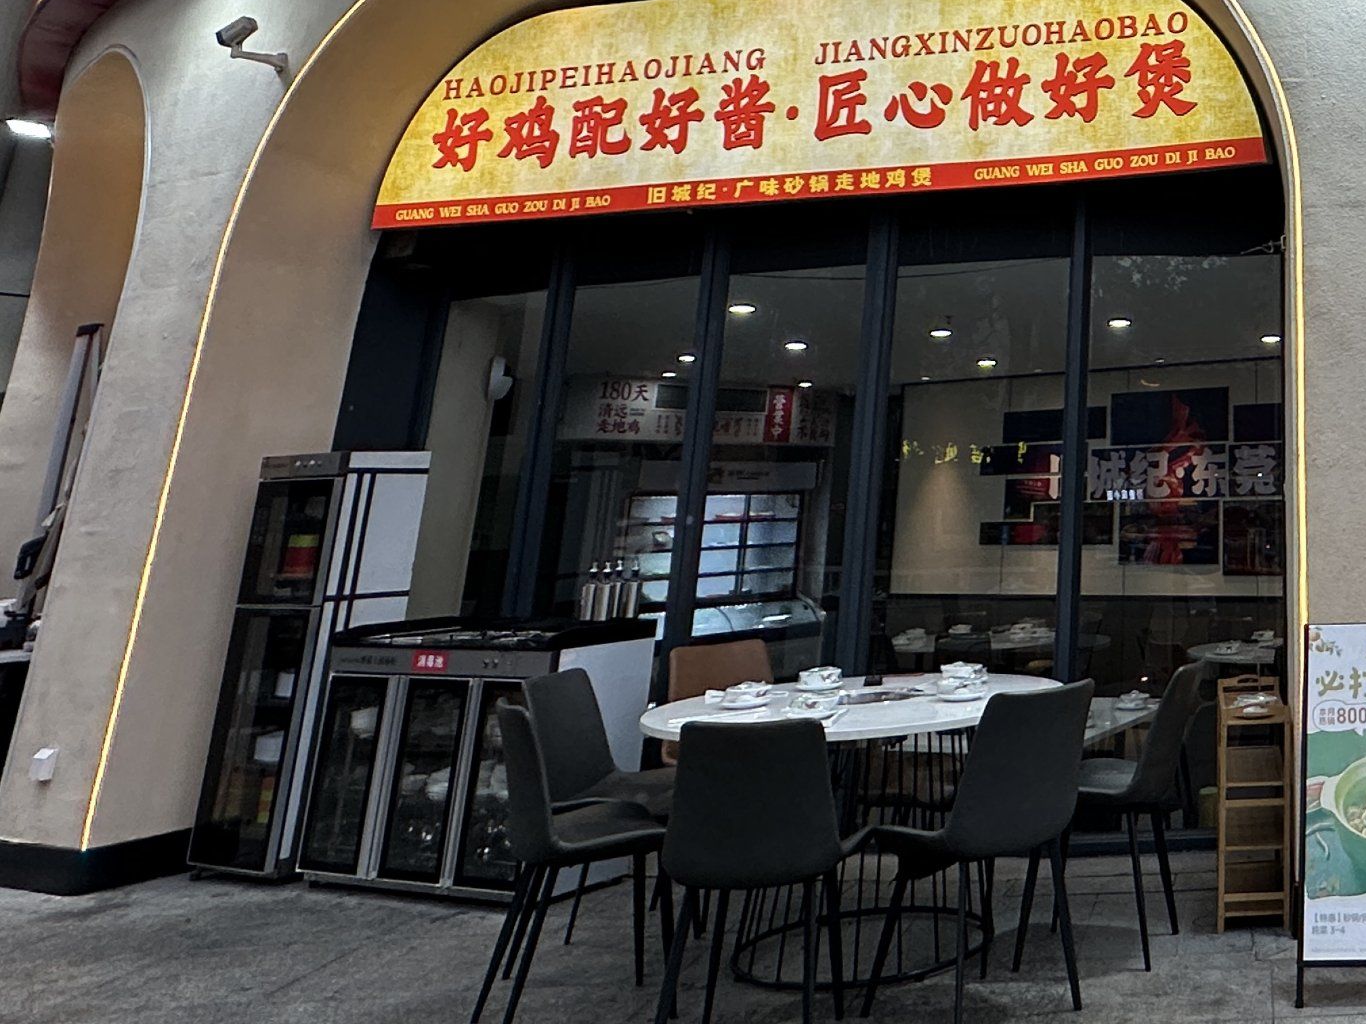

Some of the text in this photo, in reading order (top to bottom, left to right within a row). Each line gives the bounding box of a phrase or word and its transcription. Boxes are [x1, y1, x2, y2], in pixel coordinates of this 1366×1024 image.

[814, 11, 1189, 66] JIANGXINZUOHAOBAO
[442, 47, 767, 101] HAOJIPEIHAOJIANG
[973, 146, 1236, 181] GUANG WEI SHA GUO ZOU DI JI BAO
[646, 167, 933, 206] 旧城纪·广味砂锅走地鸡煲
[395, 194, 611, 221] GUANG WEI SHA GUO ZOU DI JI BAO
[601, 381, 650, 402] 180天
